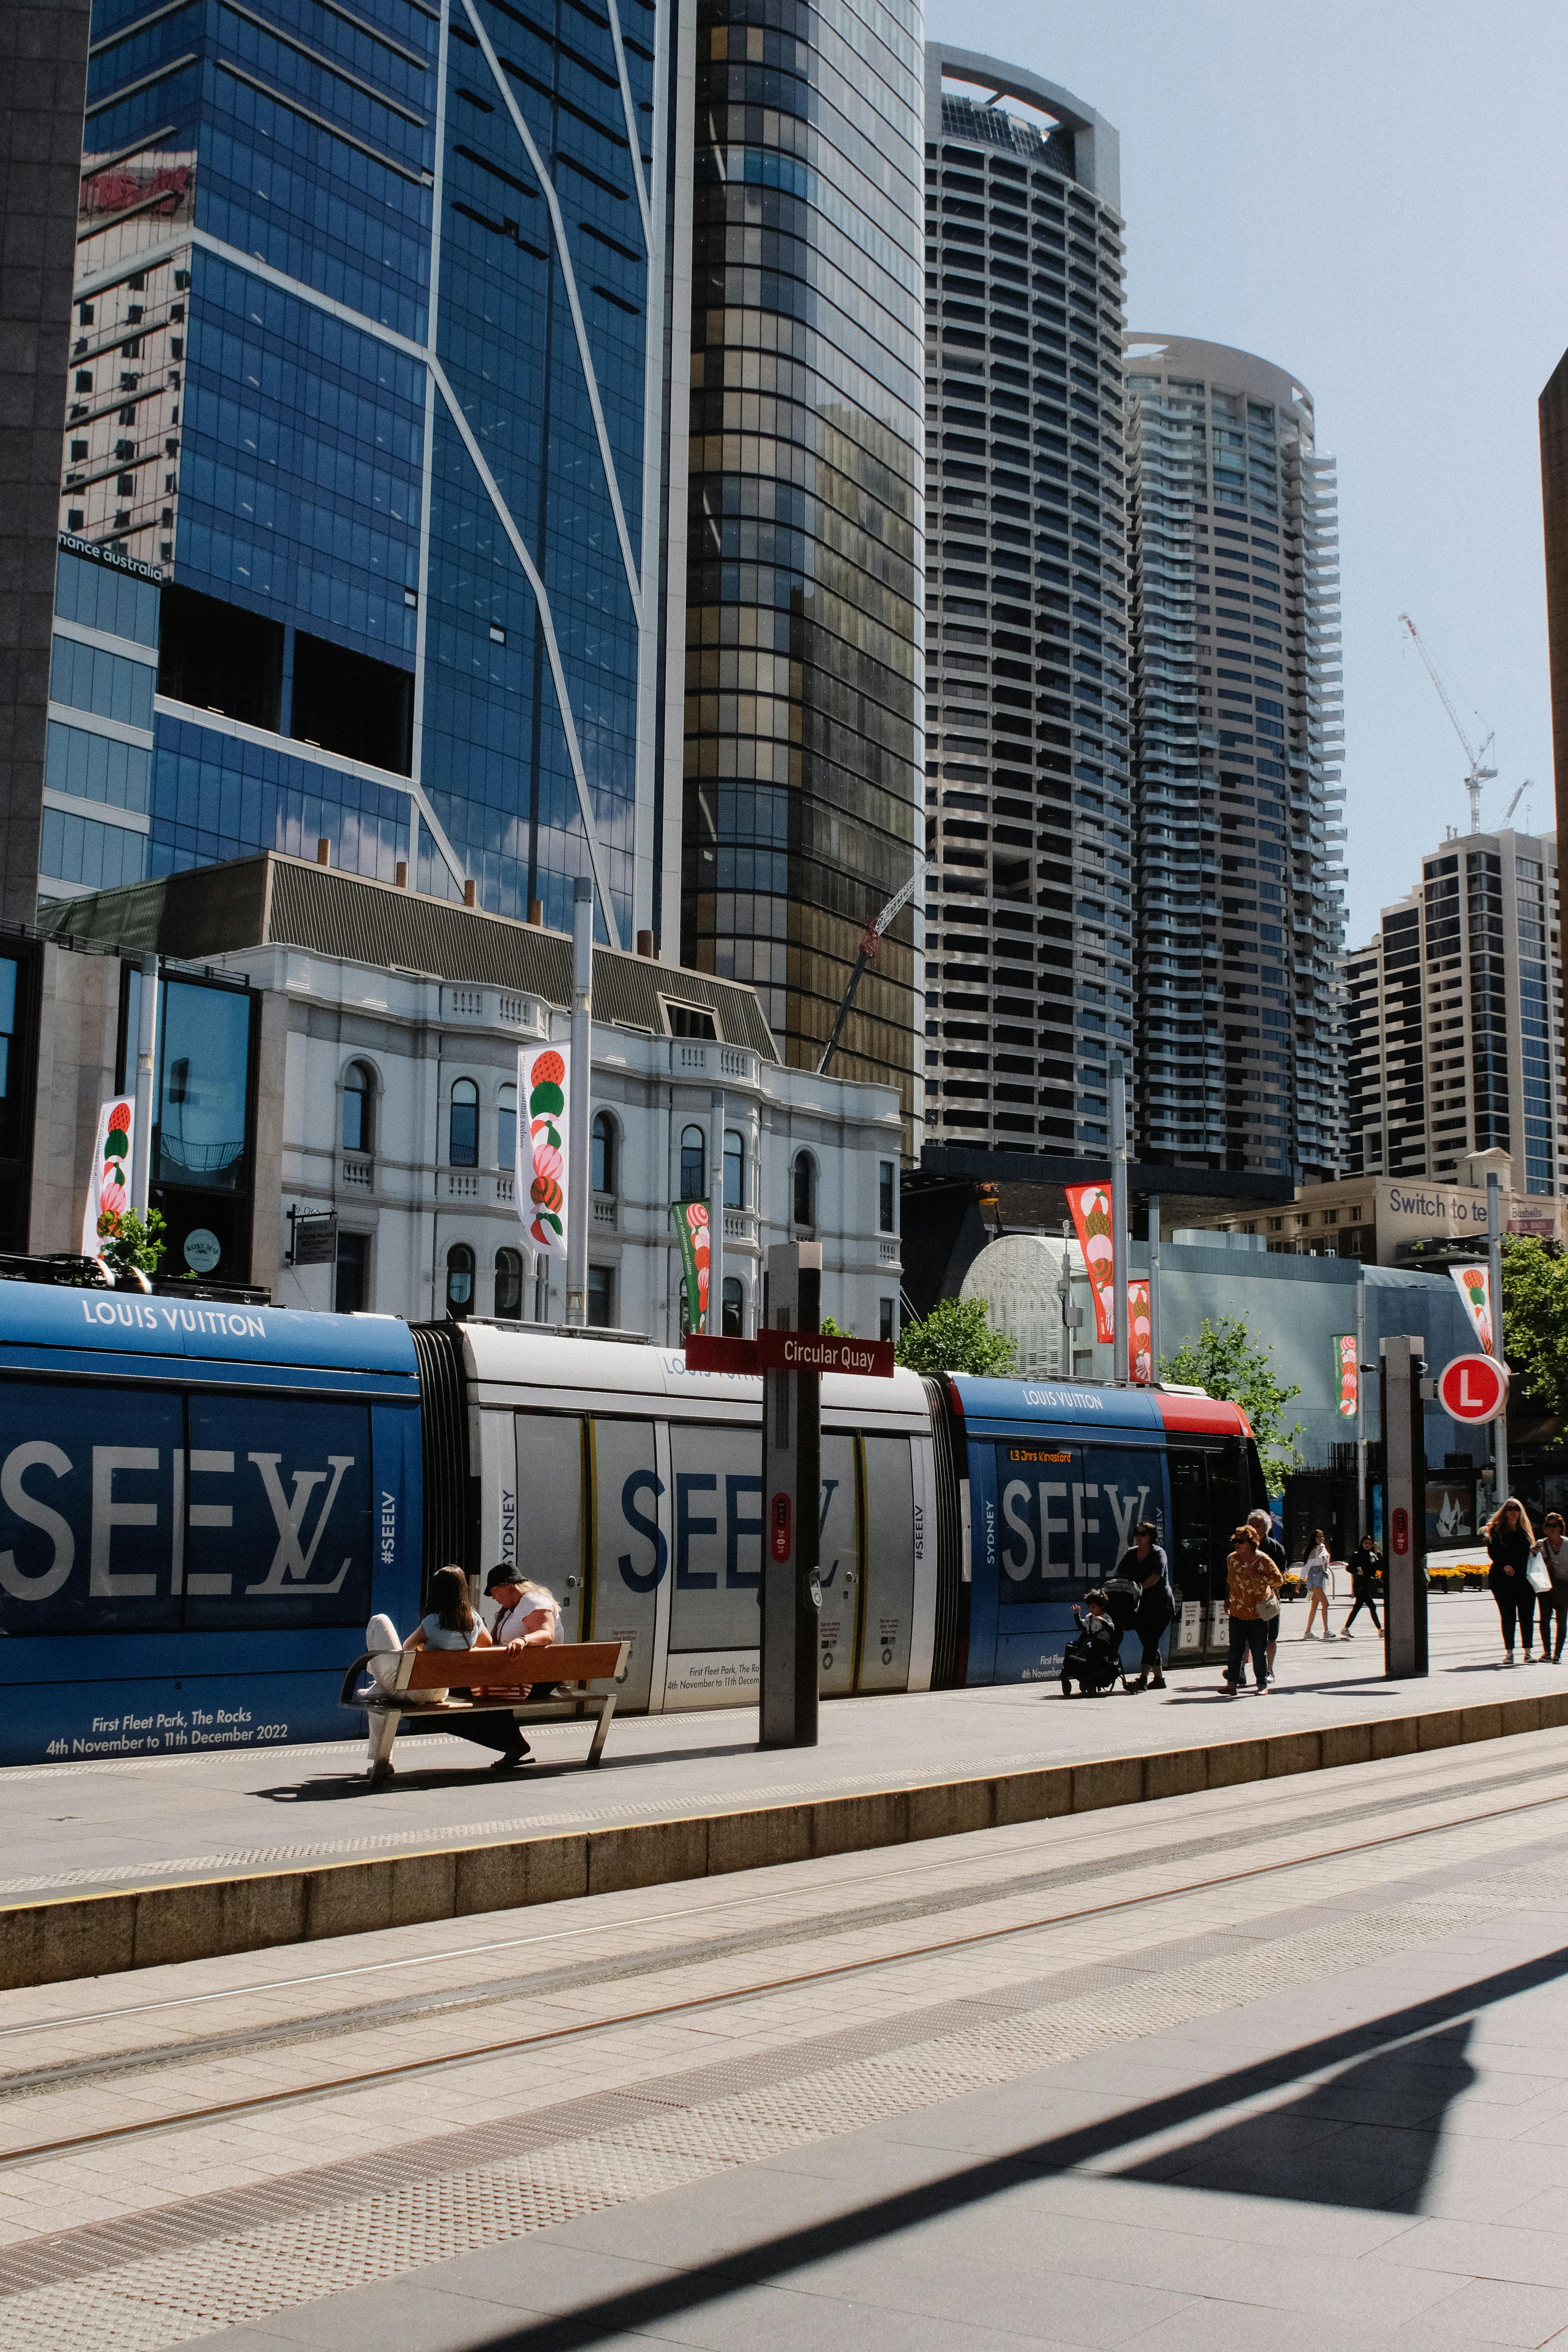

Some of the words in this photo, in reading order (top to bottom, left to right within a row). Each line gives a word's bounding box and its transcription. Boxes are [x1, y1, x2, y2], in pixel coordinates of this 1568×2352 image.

[59, 534, 100, 558] nance
[103, 551, 162, 581] australia
[1389, 1189, 1446, 1218] Switch
[1451, 1198, 1468, 1220] to
[1472, 1201, 1487, 1222] te
[1511, 1207, 1542, 1218] Bushells
[681, 1224, 689, 1254] christmas
[82, 1300, 158, 1330] LOUIS
[161, 1308, 266, 1338] VUITTON
[784, 1340, 838, 1364] Circular
[841, 1346, 875, 1372] Quay
[1023, 1390, 1056, 1406] LOUIS
[1056, 1392, 1103, 1409] VUITTON
[1460, 1369, 1483, 1407] L
[1011, 1450, 1019, 1461] L3
[381, 1491, 395, 1564] #SEELV
[915, 1505, 923, 1561] #SEELV
[986, 1500, 995, 1564] SYDNEY
[690, 1667, 703, 1676] First
[704, 1665, 719, 1675] Fleet
[721, 1664, 737, 1675] Park,
[739, 1663, 750, 1673] The
[1021, 1668, 1031, 1679] 4th
[1032, 1666, 1062, 1678] November
[1040, 1655, 1052, 1665] First
[1053, 1653, 1065, 1664] Flee
[667, 1679, 678, 1690] 4th
[680, 1678, 714, 1689] November
[725, 1676, 737, 1686] 11th
[738, 1676, 759, 1685] Decem
[92, 1717, 120, 1732] First
[122, 1714, 153, 1730] Fleet
[156, 1711, 188, 1729] Park,
[191, 1710, 213, 1725] The
[216, 1707, 252, 1724] Rocks
[46, 1738, 69, 1755] 4th
[72, 1734, 144, 1754] November
[147, 1737, 159, 1748] to
[165, 1731, 188, 1746] 11th
[191, 1726, 254, 1745] December
[257, 1724, 288, 1740] 2022
